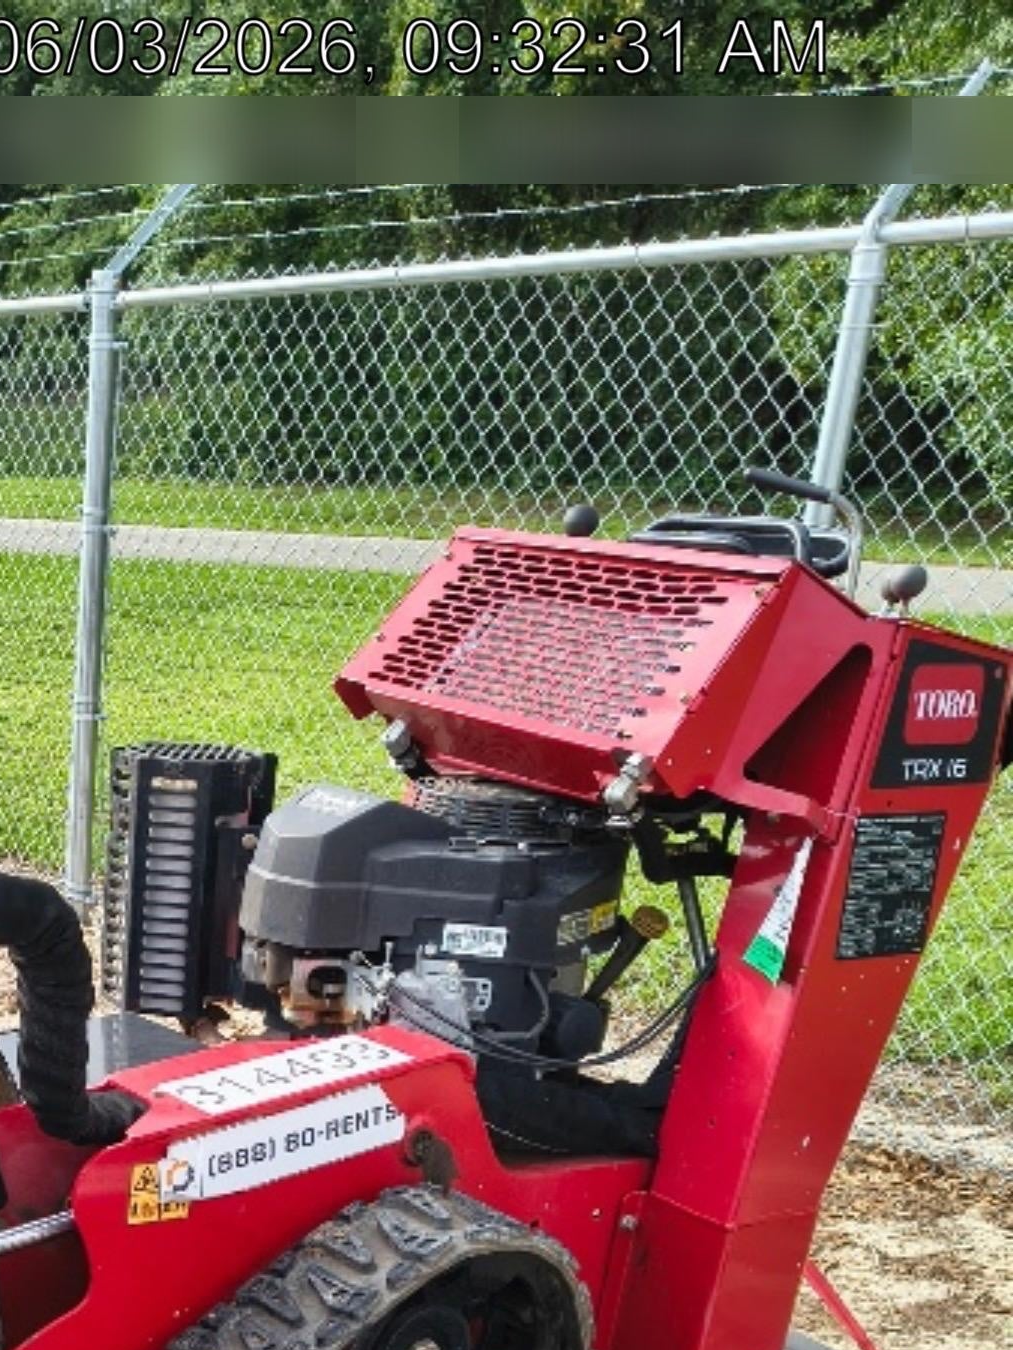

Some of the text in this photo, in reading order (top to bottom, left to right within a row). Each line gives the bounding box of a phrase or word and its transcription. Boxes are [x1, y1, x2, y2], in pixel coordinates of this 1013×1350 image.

[914, 689, 977, 720] TORO
[902, 758, 968, 781] TRX 16
[208, 1103, 398, 1177] (888) 80-RENTS
